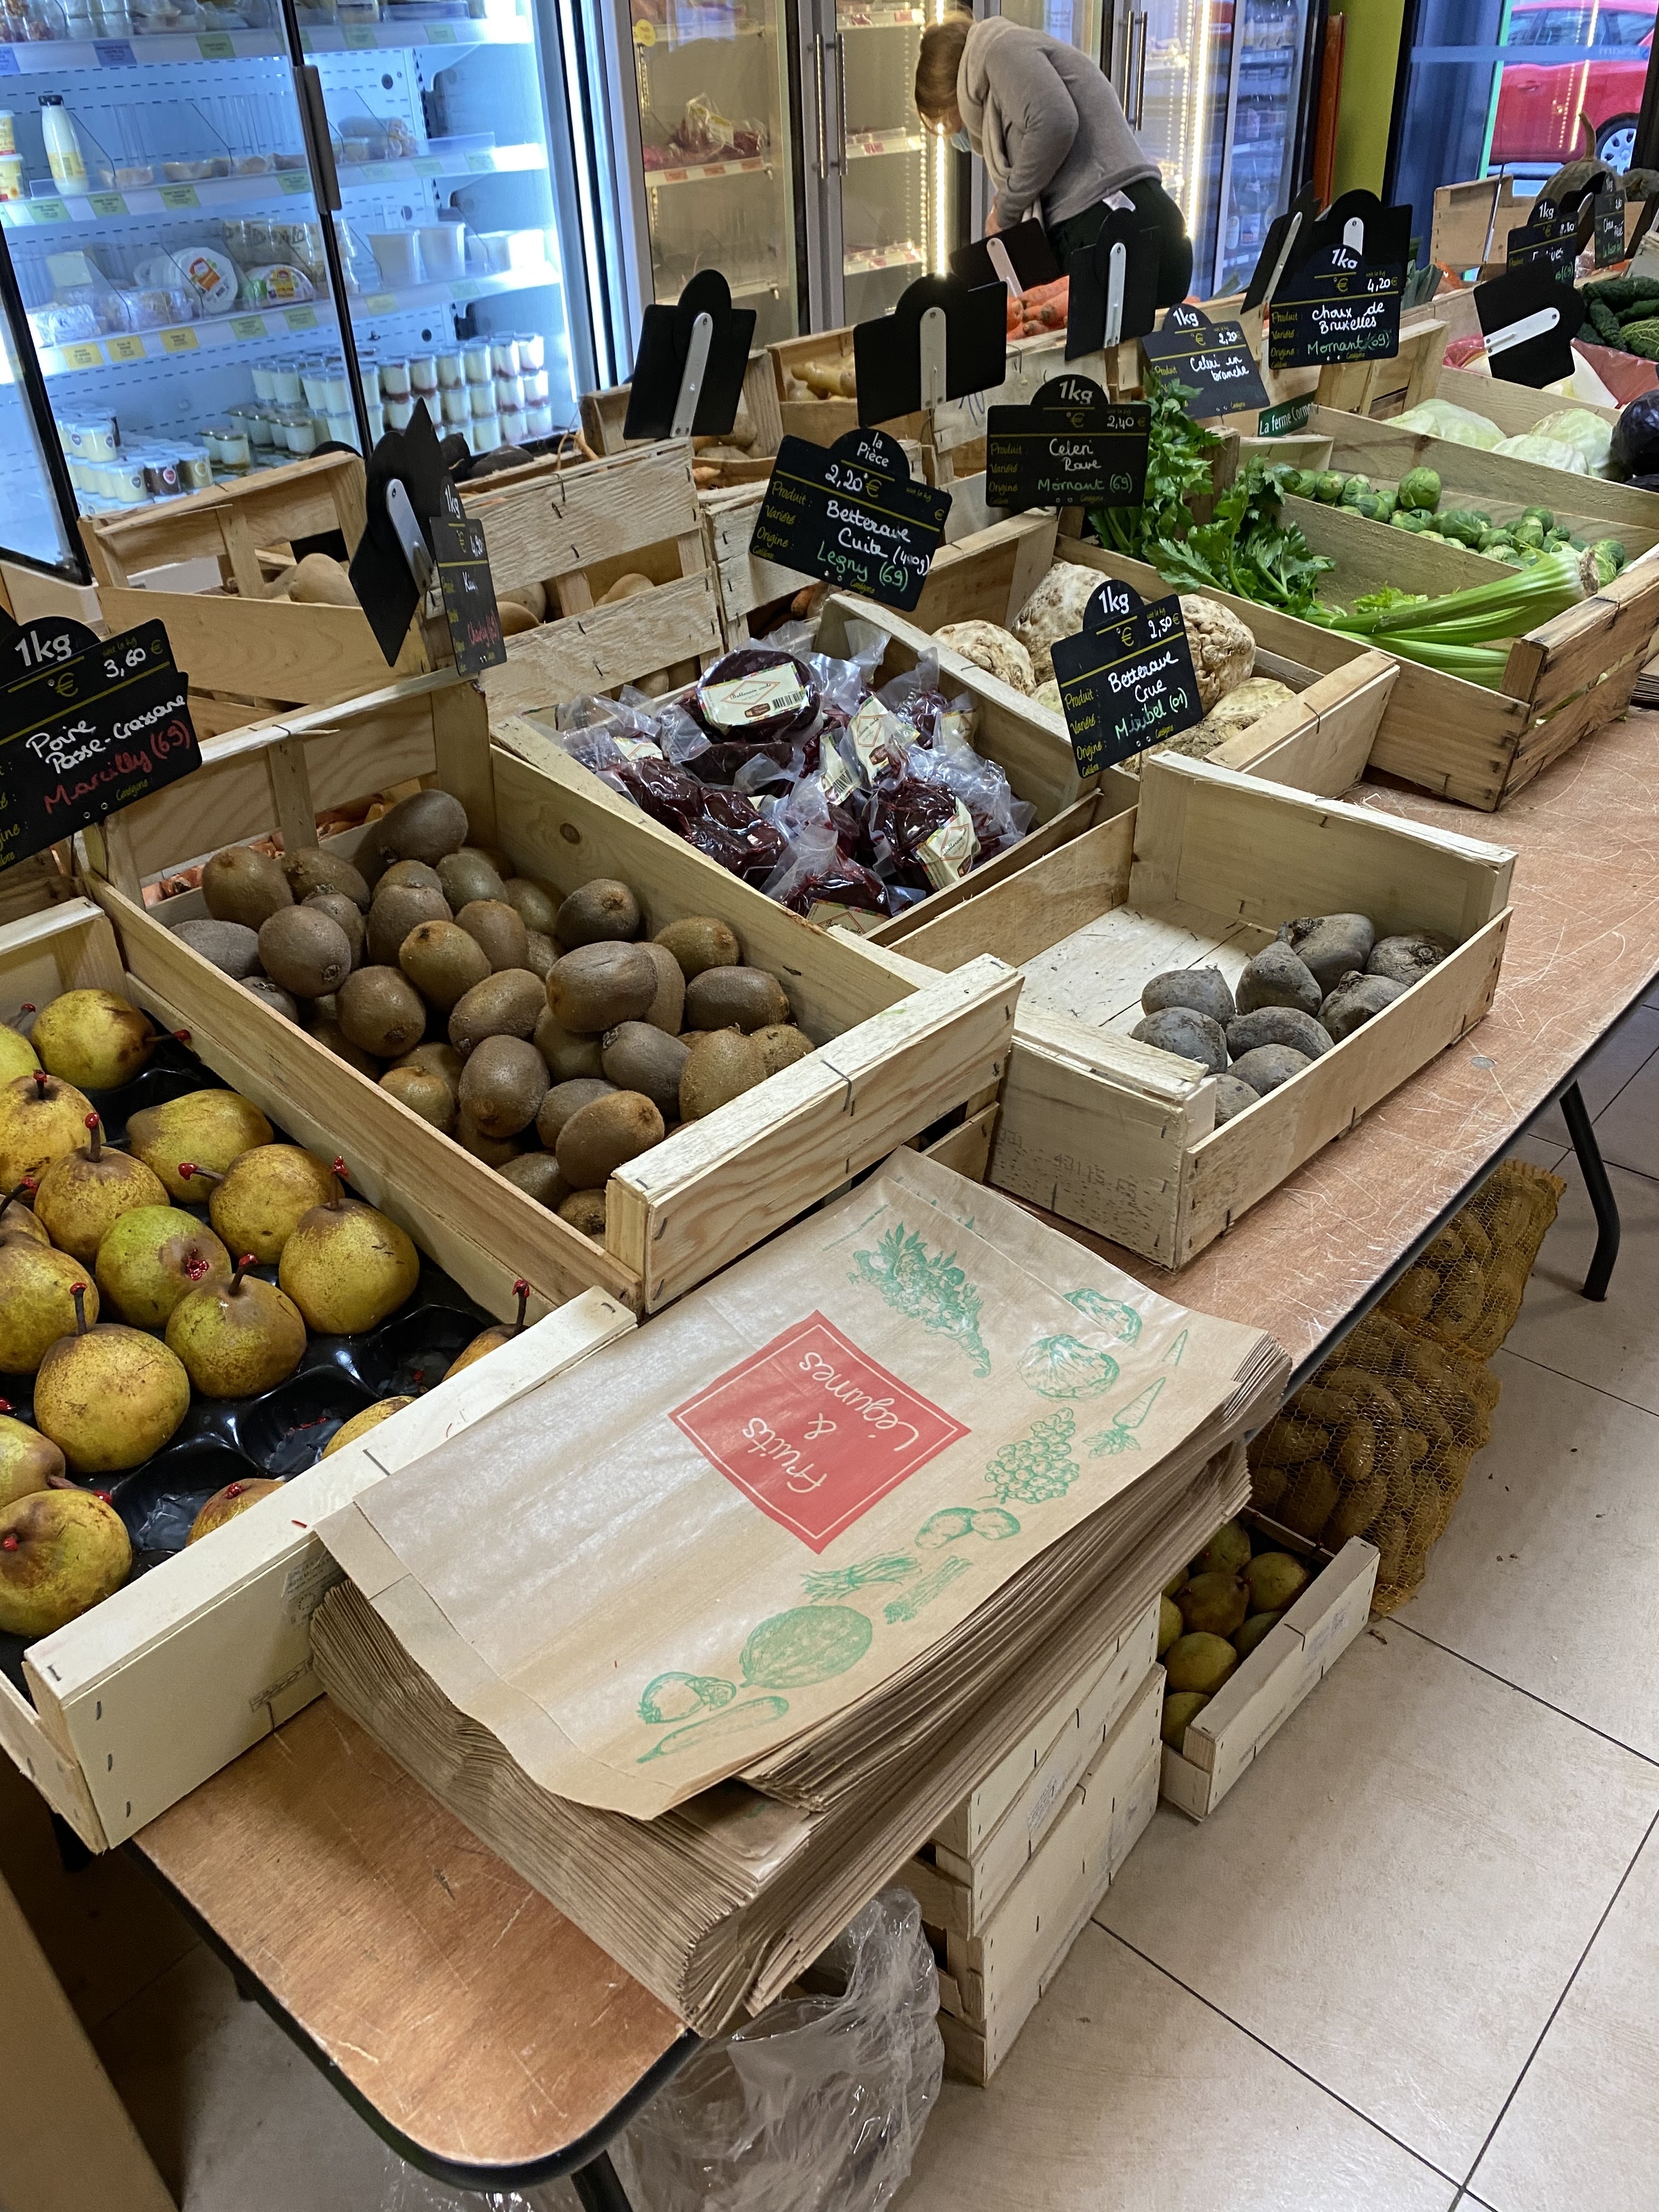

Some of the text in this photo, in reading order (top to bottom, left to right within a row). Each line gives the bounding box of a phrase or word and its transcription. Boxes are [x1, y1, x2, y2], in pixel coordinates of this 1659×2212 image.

[1539, 202, 1554, 219] 1kg
[1367, 278, 1390, 292] 4,20
[1172, 307, 1199, 327] 1kg
[1363, 301, 1385, 317] de
[1318, 315, 1377, 335] Bruxelles
[1308, 334, 1364, 356] Mornant
[1211, 364, 1250, 381] branche
[1225, 356, 1243, 366] en
[1059, 379, 1093, 404] 1kg
[1107, 415, 1135, 430] 2,40
[1259, 420, 1269, 436] La
[1271, 413, 1291, 432] ferme
[872, 432, 883, 449] la
[1049, 437, 1094, 456] Celeri
[856, 441, 889, 467] Pièce
[1064, 456, 1102, 471] Rave
[825, 464, 863, 492] 2,20
[1037, 477, 1105, 492] Mornant
[1109, 472, 1132, 494] (69)
[445, 484, 460, 519] 1kg
[771, 481, 808, 506] Produit
[826, 499, 911, 543] Betterave
[756, 526, 789, 549] Origine
[838, 527, 889, 558] Cuite
[816, 541, 909, 591] Legny (69)
[1098, 585, 1128, 614] 1kg
[14, 630, 72, 667] 1kg
[103, 647, 146, 678] 3,60
[1108, 650, 1179, 693] Betterave
[1064, 688, 1094, 711] Produit
[1134, 679, 1167, 703] Crue
[1114, 699, 1167, 740] Miribel
[26, 720, 97, 758] Poire
[1076, 741, 1102, 761] Origine
[44, 719, 191, 814] Marcilly (69)
[799, 1350, 920, 1452] Légumes
[803, 1412, 838, 1440] &
[741, 1416, 827, 1494] Fruits
